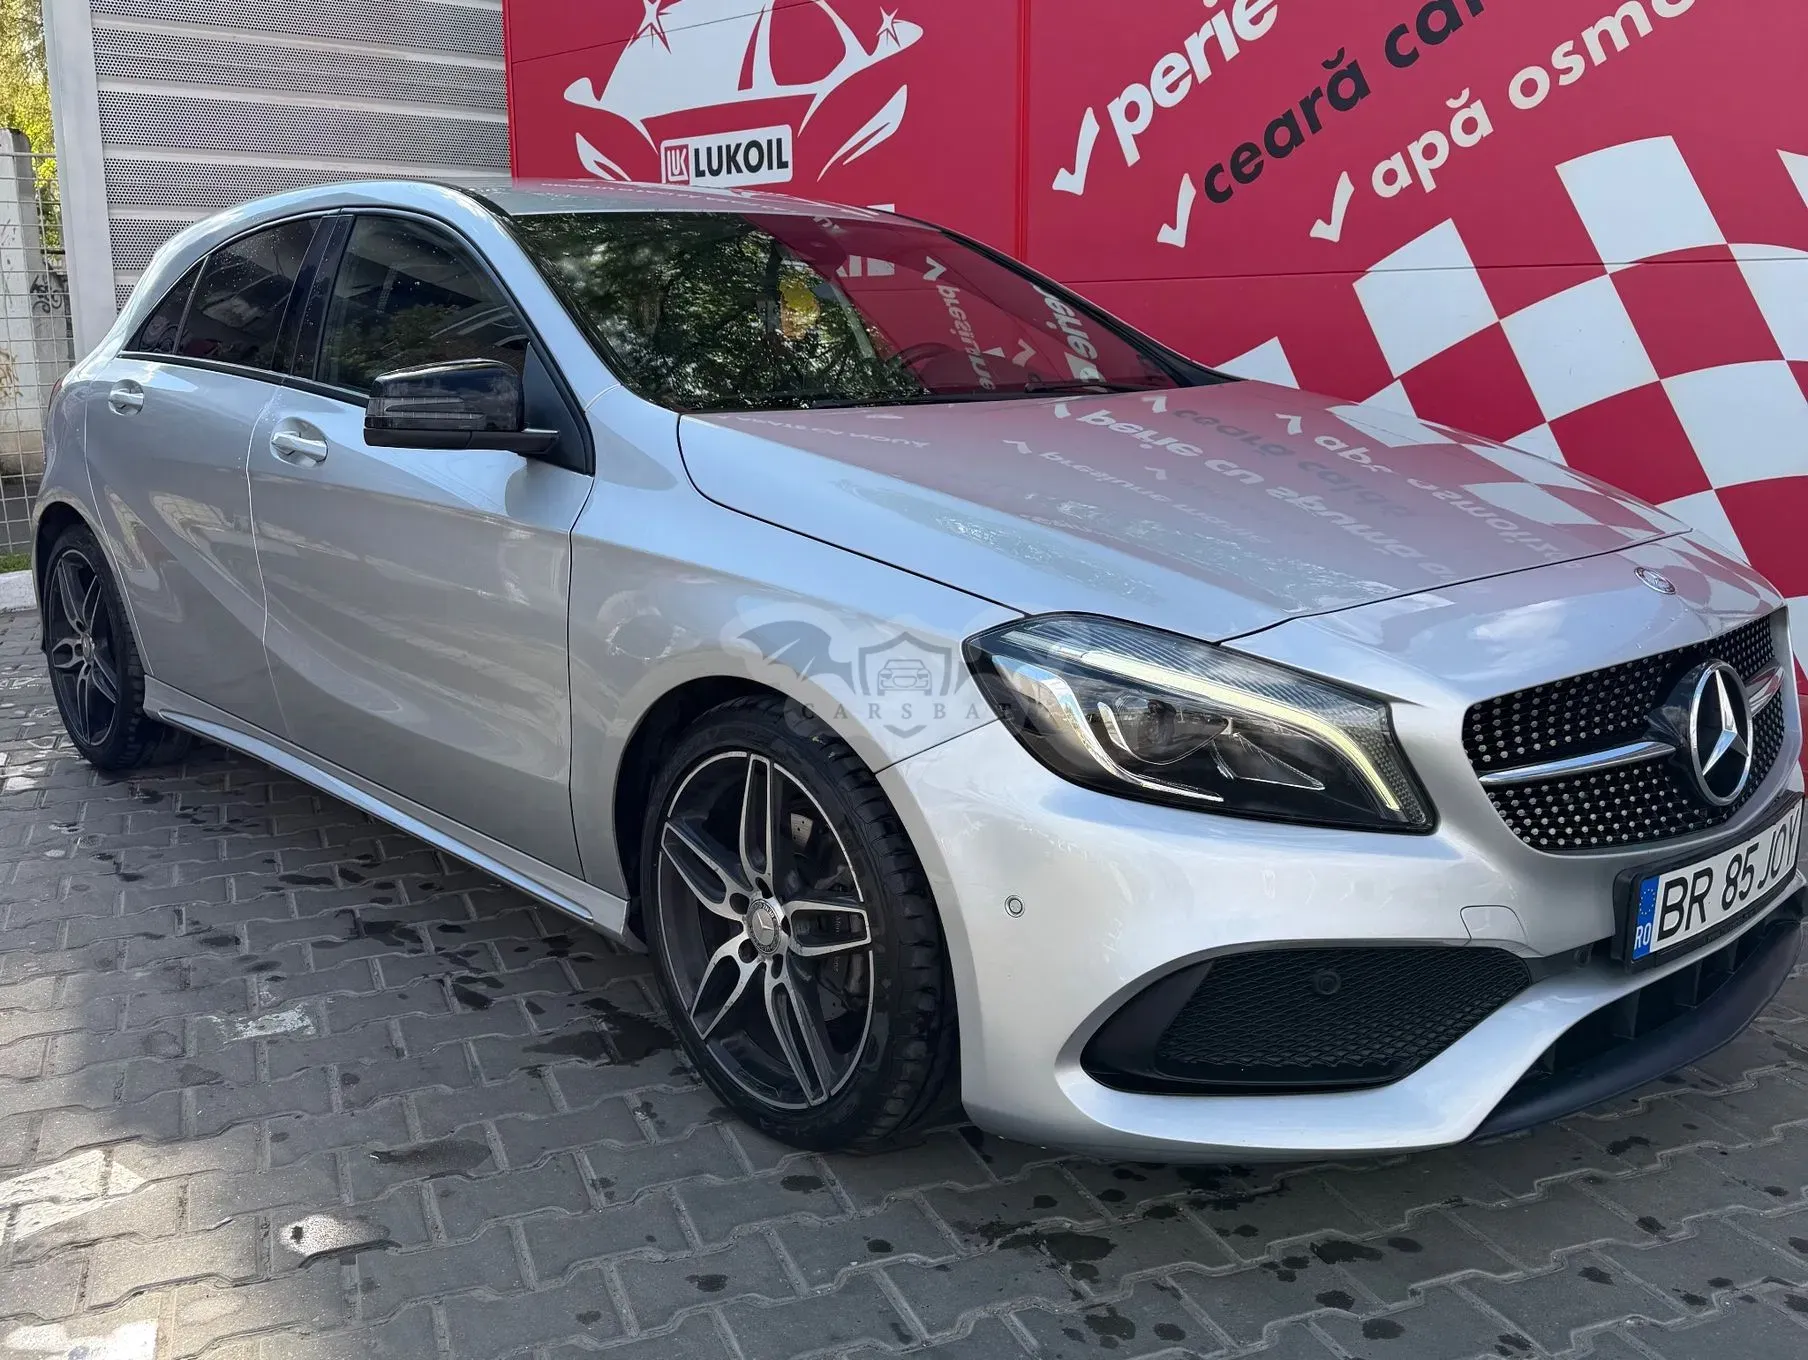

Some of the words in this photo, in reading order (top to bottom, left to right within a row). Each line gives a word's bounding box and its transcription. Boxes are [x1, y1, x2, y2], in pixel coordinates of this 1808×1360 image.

[1107, 0, 1278, 167] perie
[1204, 47, 1370, 203] ceară
[1385, 0, 1484, 68] ca
[1372, 88, 1494, 198] apă
[694, 138, 789, 178] LUKOIL
[1657, 867, 1713, 941] BR
[1722, 842, 1759, 910] 85
[1757, 807, 1800, 889] JOY
[1634, 922, 1651, 950] RO
